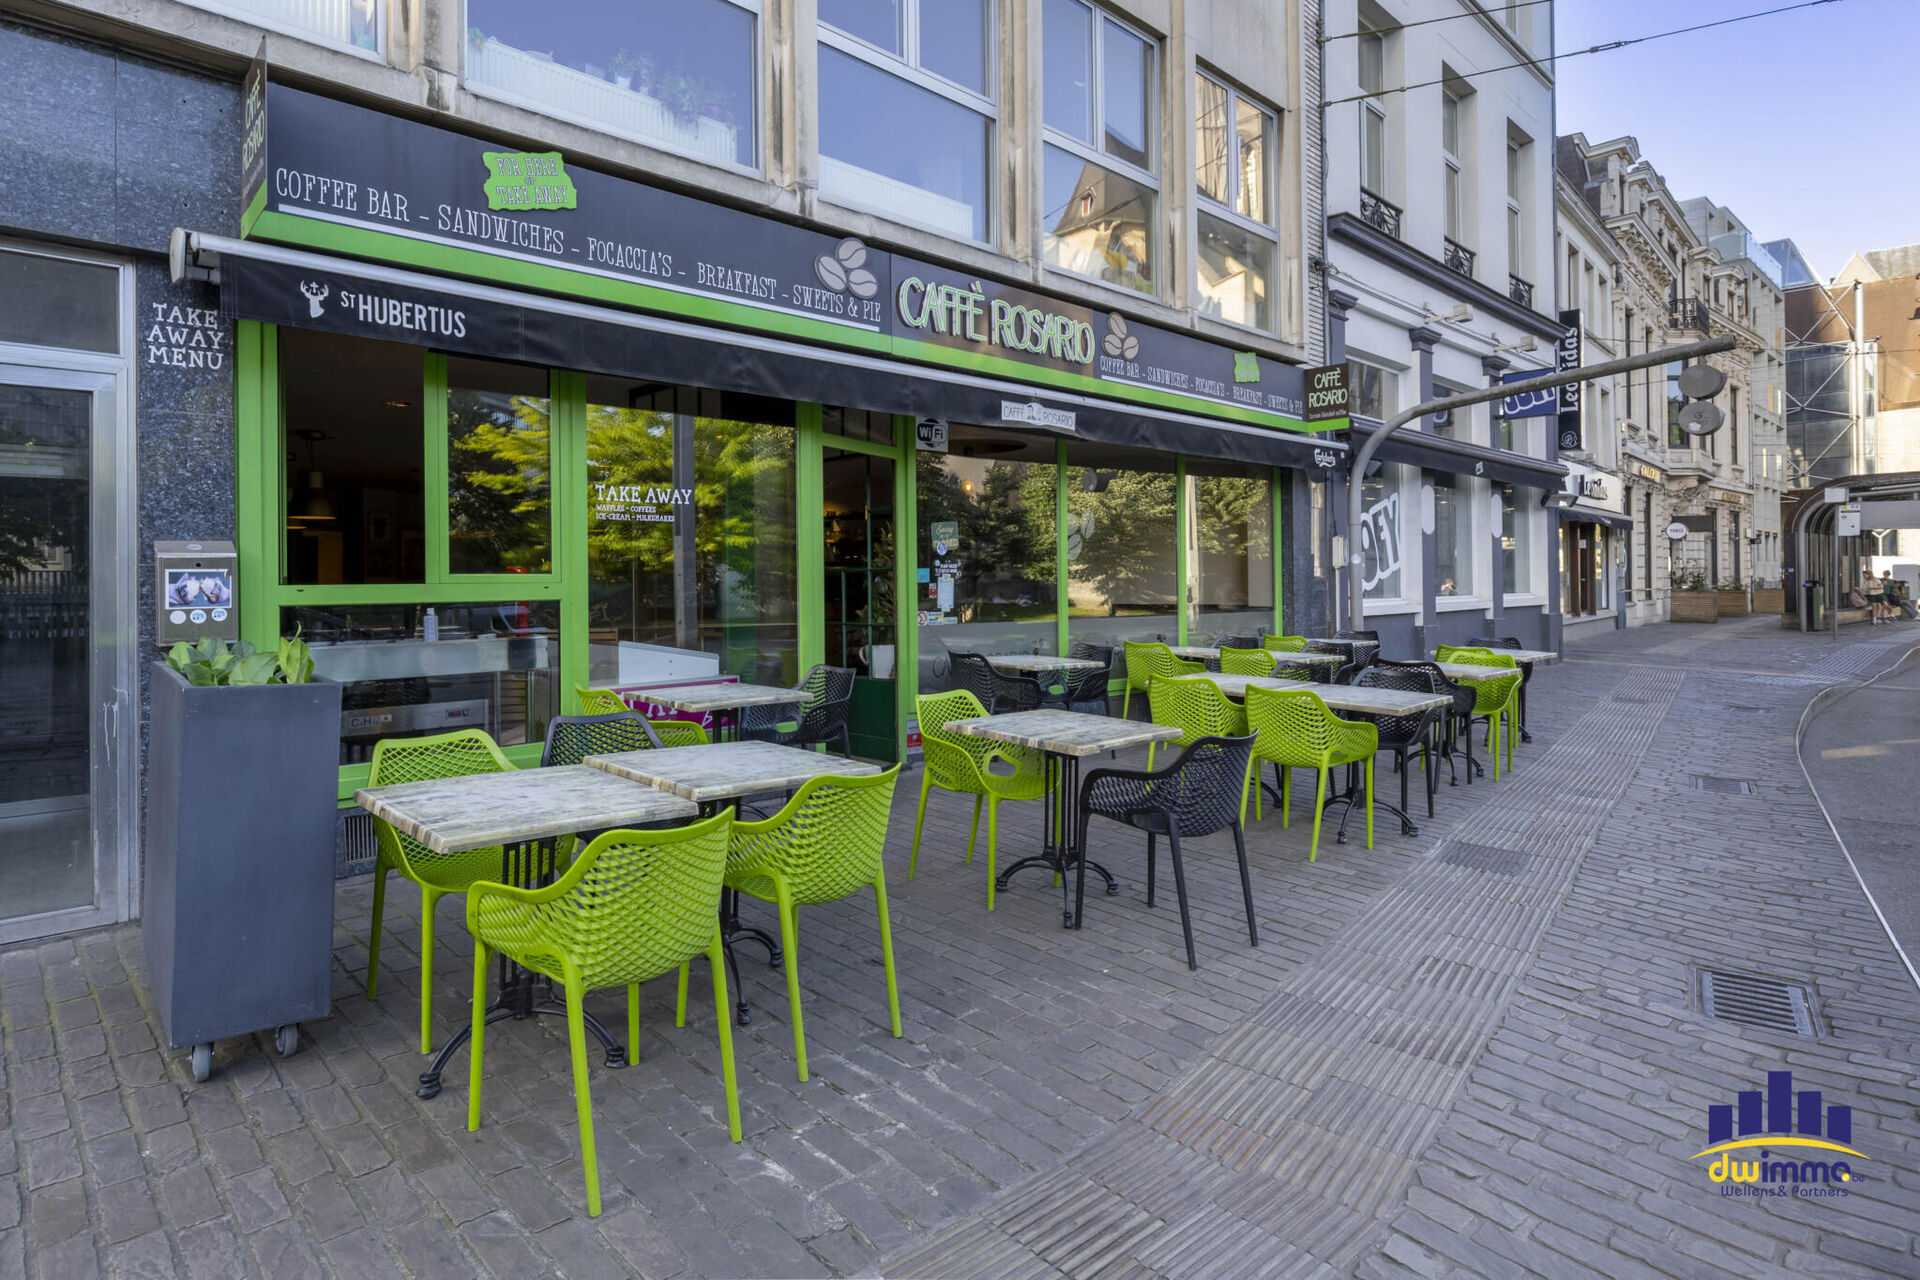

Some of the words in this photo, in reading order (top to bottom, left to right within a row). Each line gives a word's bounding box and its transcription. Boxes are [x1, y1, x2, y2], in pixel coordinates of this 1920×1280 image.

[496, 158, 522, 175] FOR
[524, 157, 559, 176] HERE
[496, 186, 530, 204] TAKE
[535, 185, 569, 204] AWAY
[276, 168, 357, 211] COFFEE
[367, 187, 410, 222] BAR
[438, 204, 564, 254] SANDWICHES
[587, 237, 672, 277] FOCACCIA'S
[697, 262, 777, 299] BREAKFAST
[793, 284, 843, 314] SWEETS
[847, 297, 858, 318] &
[863, 300, 881, 322] PIE
[153, 303, 218, 330] TAKE
[358, 294, 466, 338] HUBERTUS
[899, 277, 988, 341] CAFFÈ
[990, 299, 1095, 364] ROSARIO
[147, 325, 224, 350] AWAY
[147, 345, 224, 370] MENU
[1559, 327, 1579, 413] Leoidas
[1100, 355, 1124, 375] COFFEE
[1126, 361, 1140, 378] BAR
[1147, 366, 1189, 389] SANDWICHES
[1233, 386, 1262, 405] BREAKFAST
[1267, 394, 1288, 411] SWEETS
[1314, 367, 1342, 389] CAFFÈ
[1308, 388, 1348, 408] ROSARIO
[595, 484, 641, 503] TAKE
[645, 488, 692, 505] AWAY
[596, 504, 625, 512] WAFFLES
[630, 505, 656, 513] COFFEES
